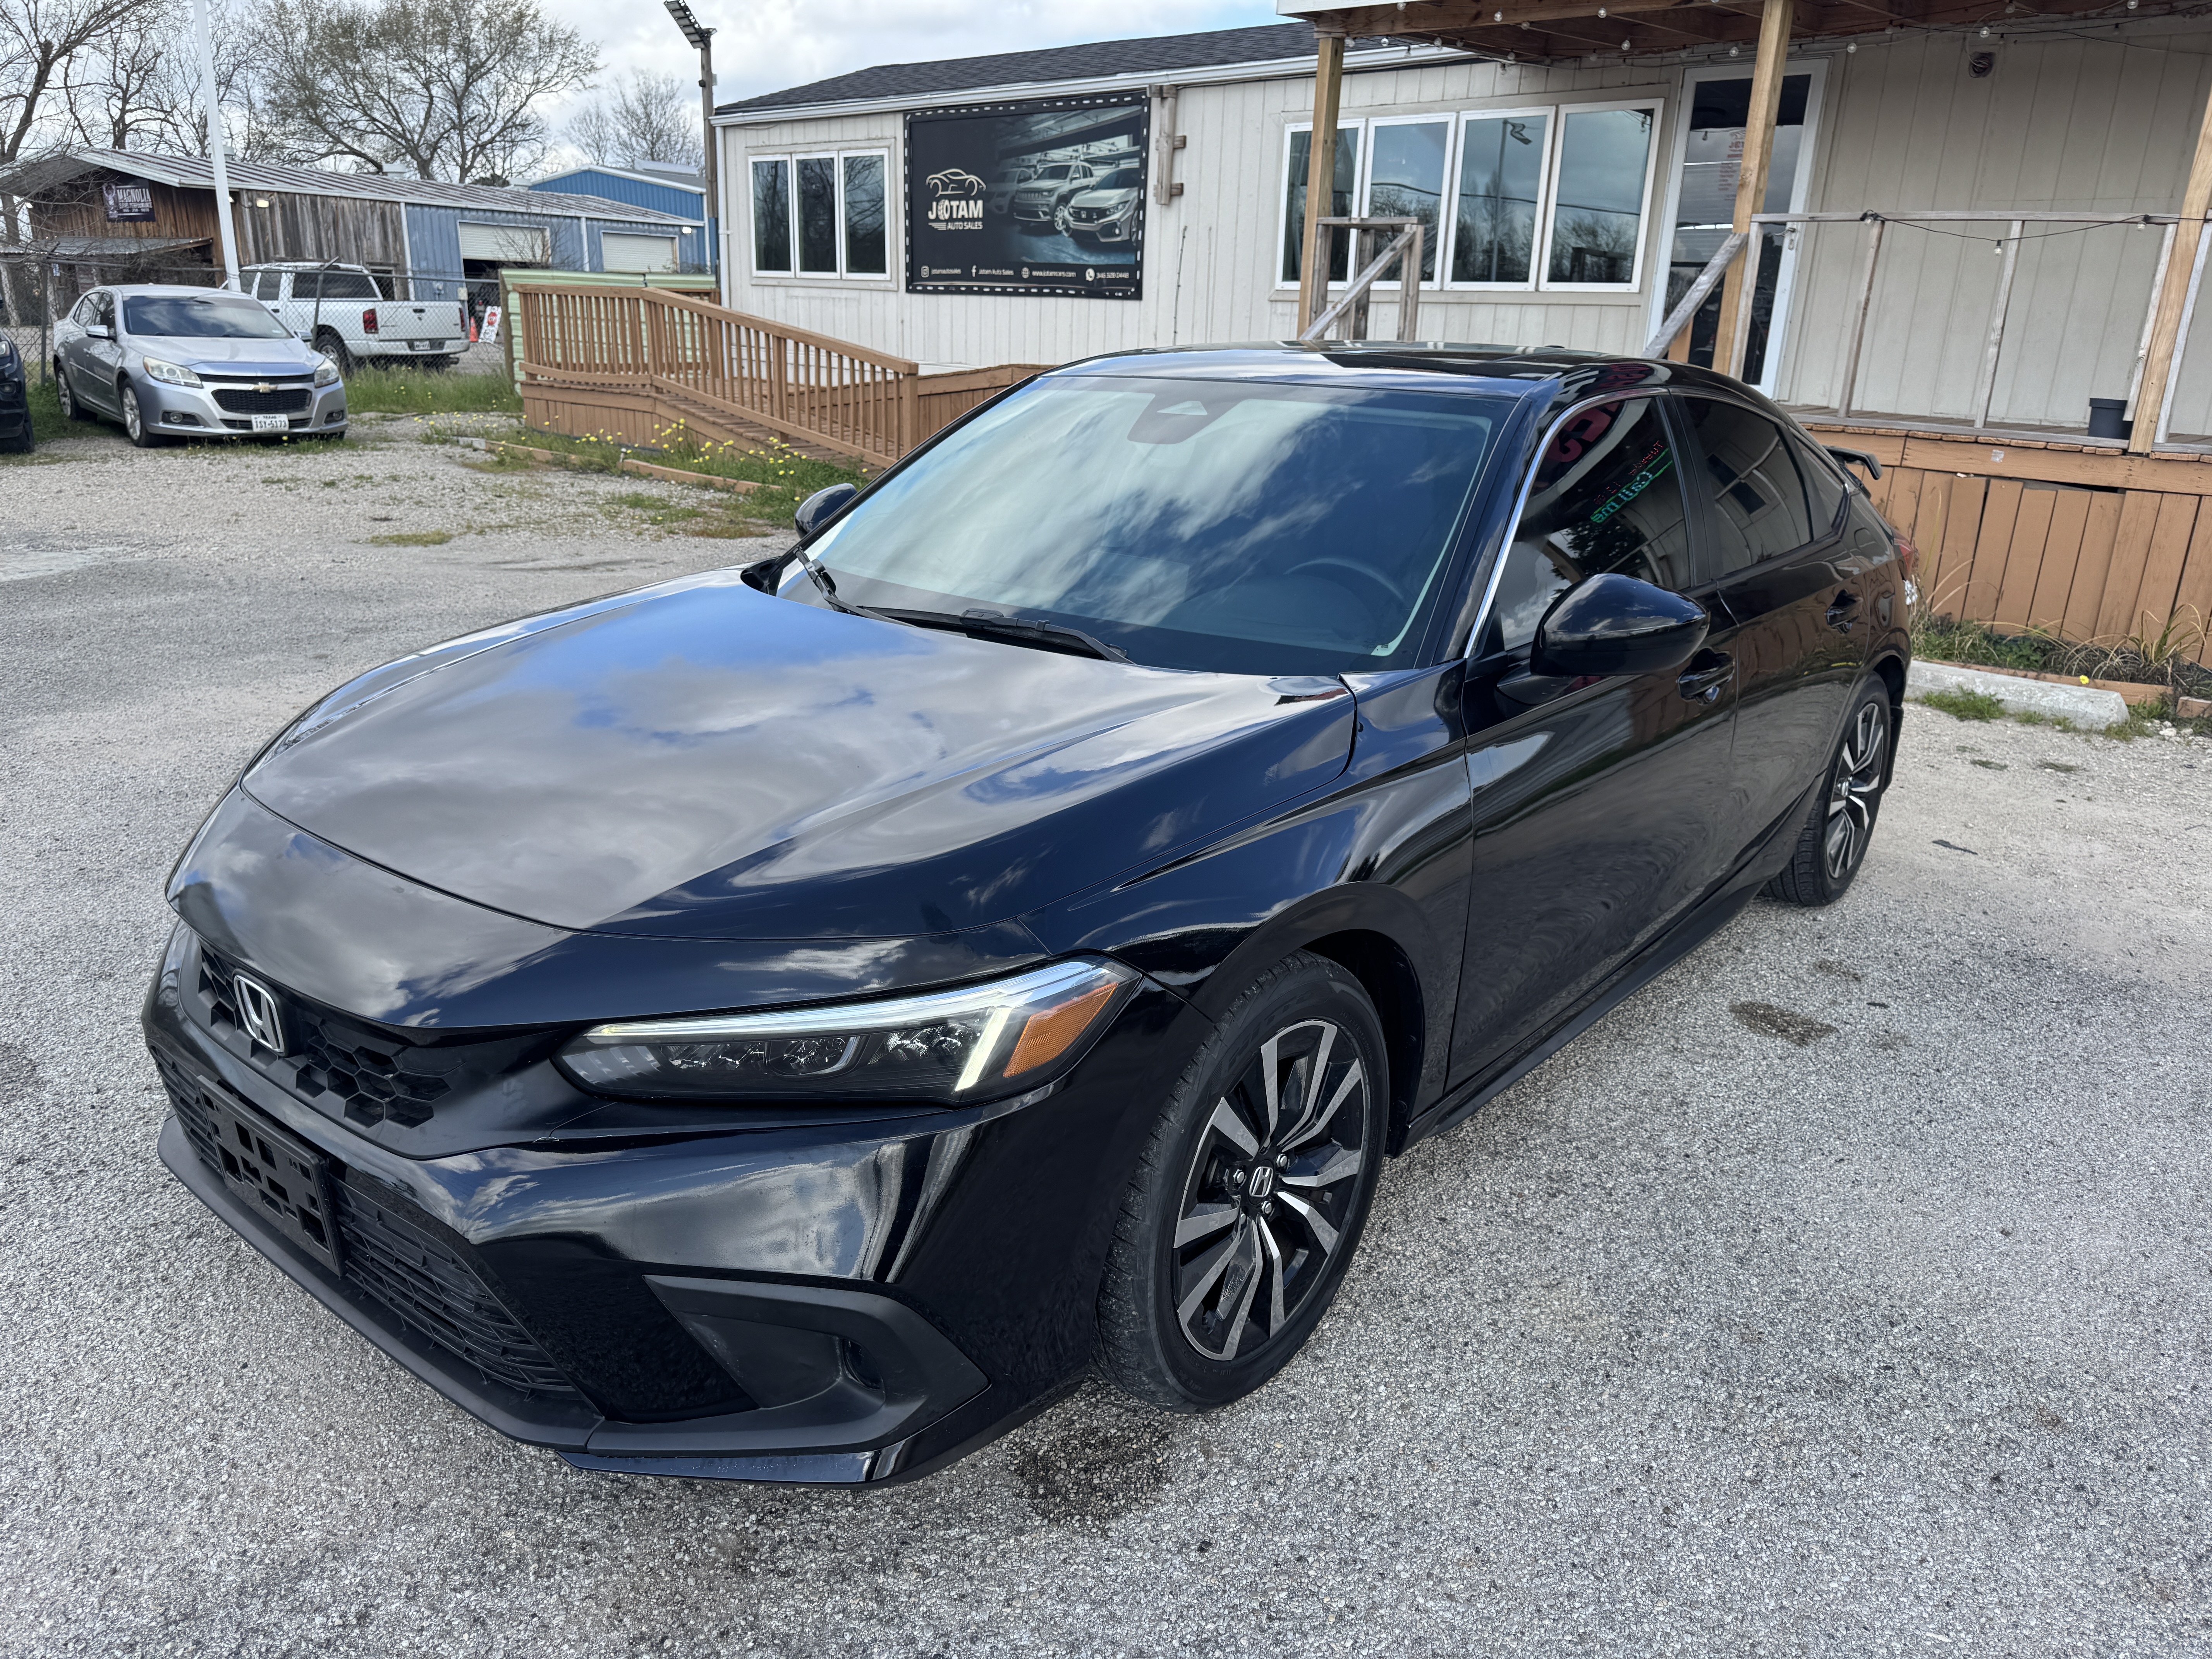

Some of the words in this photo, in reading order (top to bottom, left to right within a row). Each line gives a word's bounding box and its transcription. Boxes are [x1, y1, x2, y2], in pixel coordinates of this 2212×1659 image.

[117, 189, 151, 202] MAGNOLIA
[928, 199, 983, 220] JOTAM
[947, 221, 963, 230] AUTO
[963, 221, 983, 230] SALES
